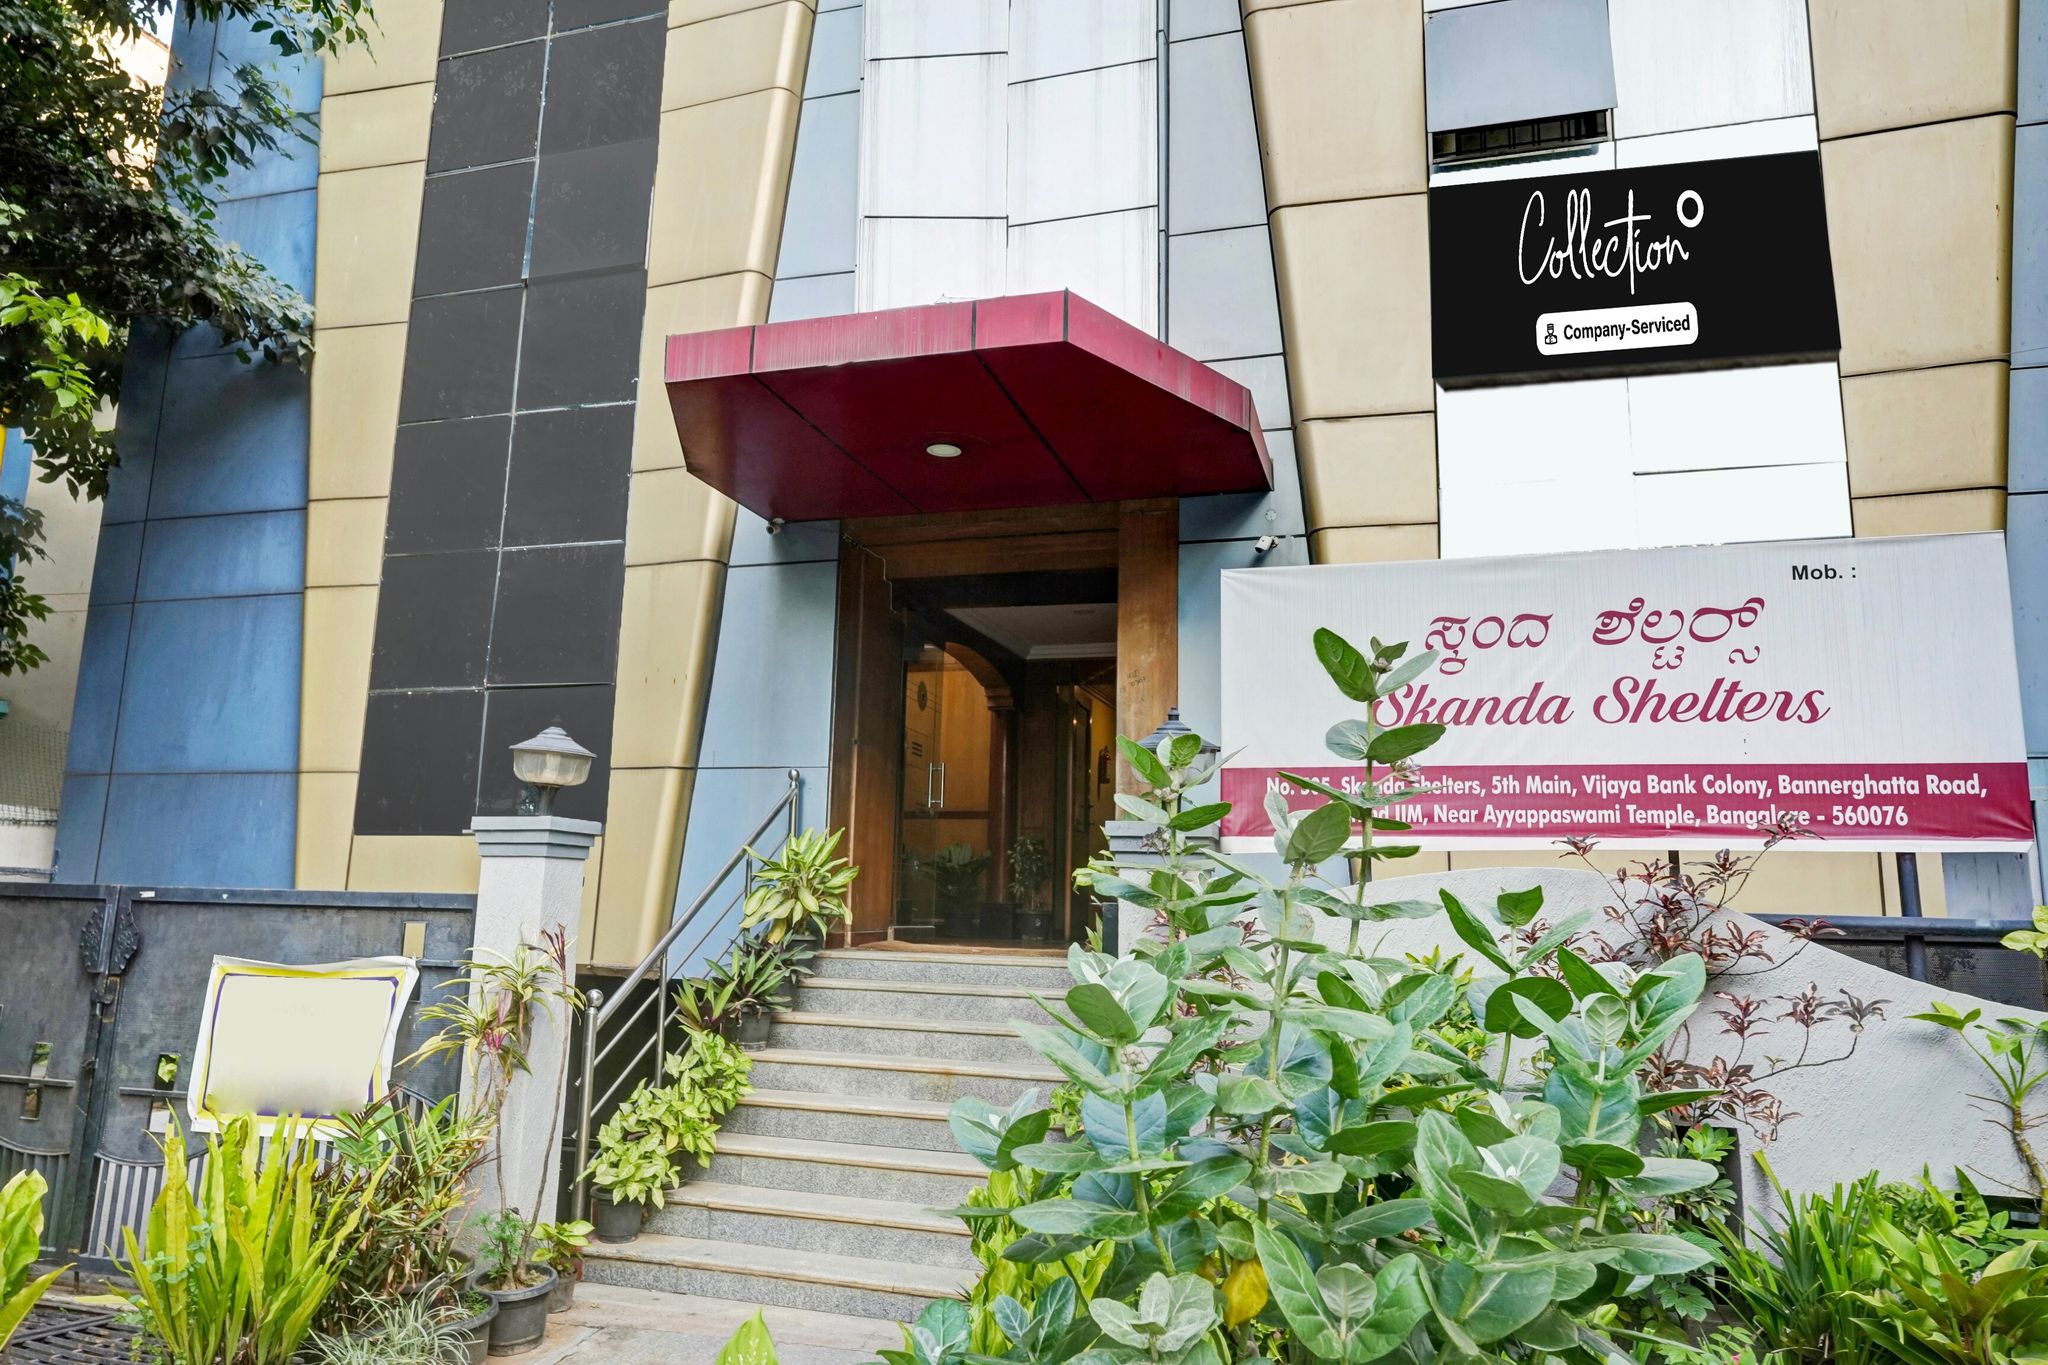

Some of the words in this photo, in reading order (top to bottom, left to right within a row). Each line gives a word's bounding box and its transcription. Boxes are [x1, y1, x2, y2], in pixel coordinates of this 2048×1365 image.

[1518, 187, 1689, 295] Collection
[1563, 314, 1690, 342] Company-Serviced
[1791, 564, 1843, 581] Mob.
[1373, 681, 1574, 727] Skanda
[1592, 676, 1831, 726] Shelters
[1266, 776, 1295, 796] No.
[1411, 774, 1486, 798] helters,
[1491, 774, 1520, 794] 5th
[1525, 775, 1578, 800] Main,
[1582, 774, 1642, 800] Vijaya
[1647, 774, 1697, 794] Bank
[1702, 774, 1772, 798] Colony,
[1778, 774, 1920, 799] Bannerghatta
[1926, 773, 1988, 799] Road,
[1434, 803, 1479, 823] Near
[1483, 803, 1620, 828] Ayyappaswami
[1626, 804, 1701, 829] Temple,
[1832, 805, 1909, 826] 560076
